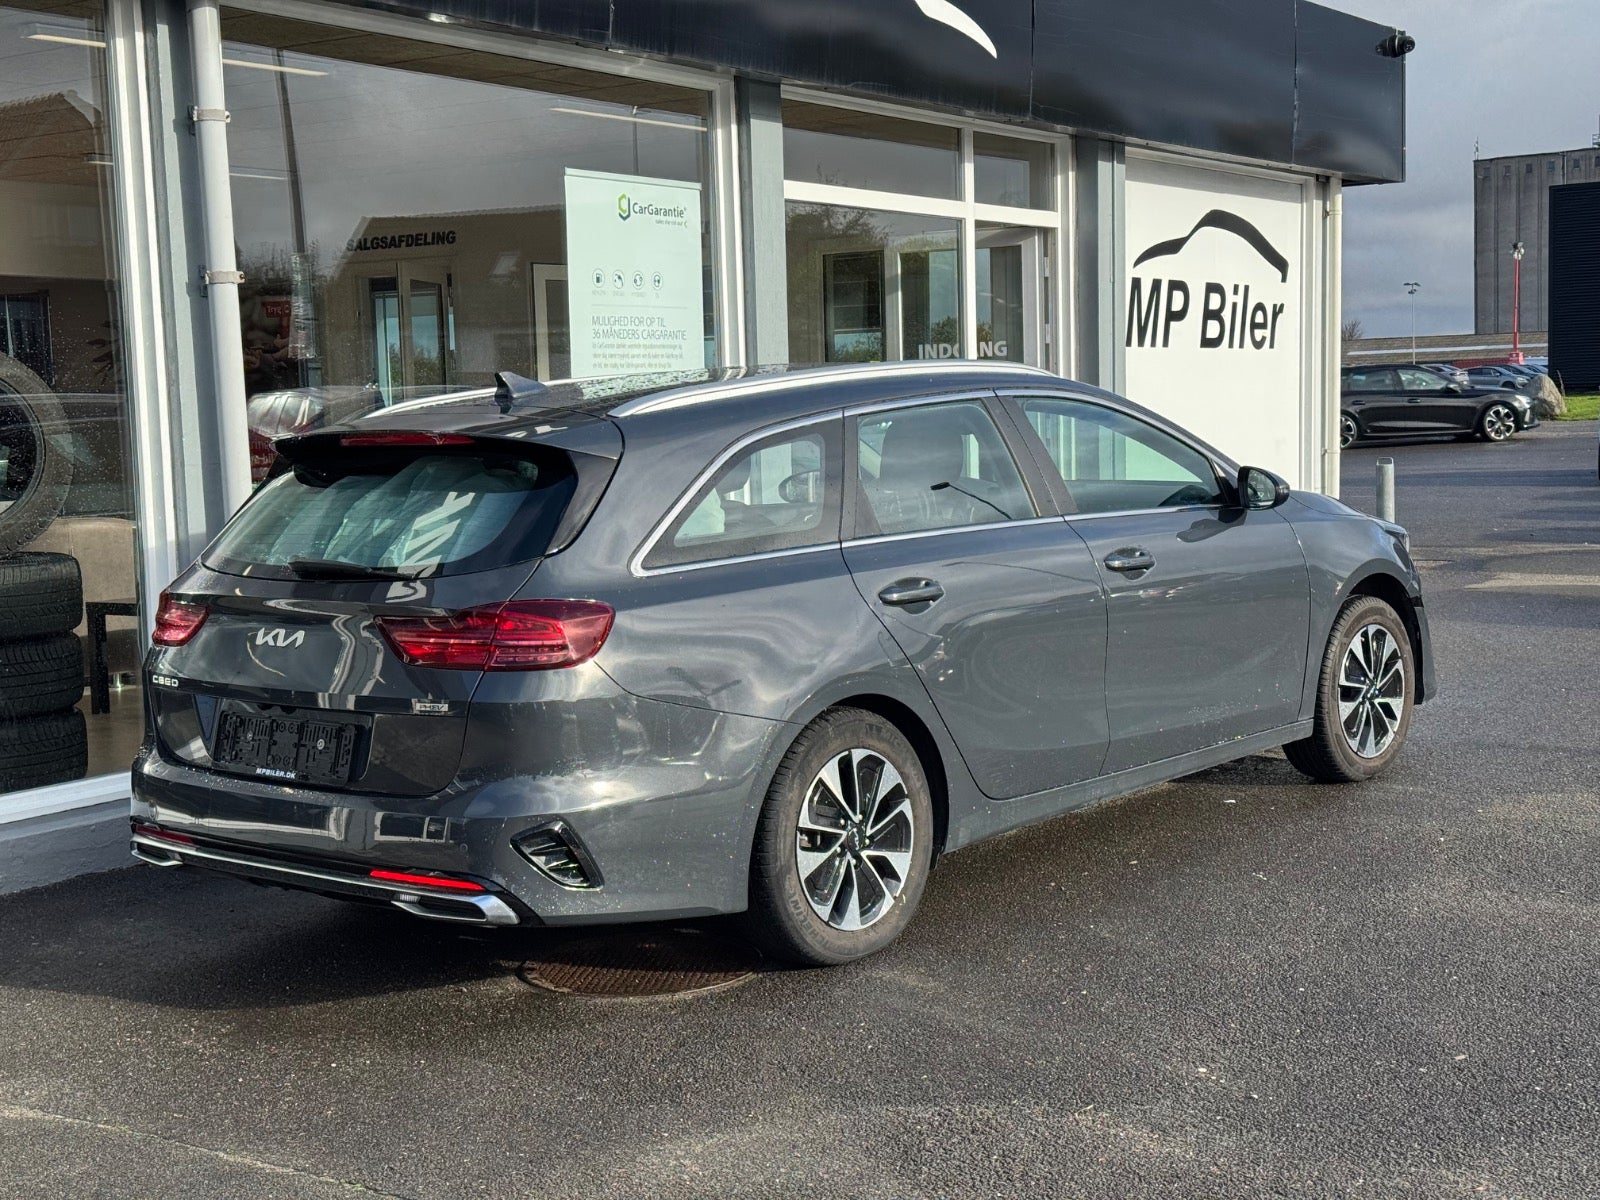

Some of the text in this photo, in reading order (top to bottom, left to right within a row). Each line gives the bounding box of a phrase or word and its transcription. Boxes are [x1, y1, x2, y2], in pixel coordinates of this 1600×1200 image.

[632, 202, 685, 218] CarGarantie
[346, 230, 457, 252] SALGSAFDELING
[592, 315, 666, 328] MULIGHED FOR OP TIL
[1126, 277, 1285, 350] MP Biler
[592, 327, 687, 341] 36 MÅNEDERS CARGARANTIE
[918, 341, 1008, 360] INDNG
[255, 627, 305, 648] KIA
[152, 675, 179, 687] CEED
